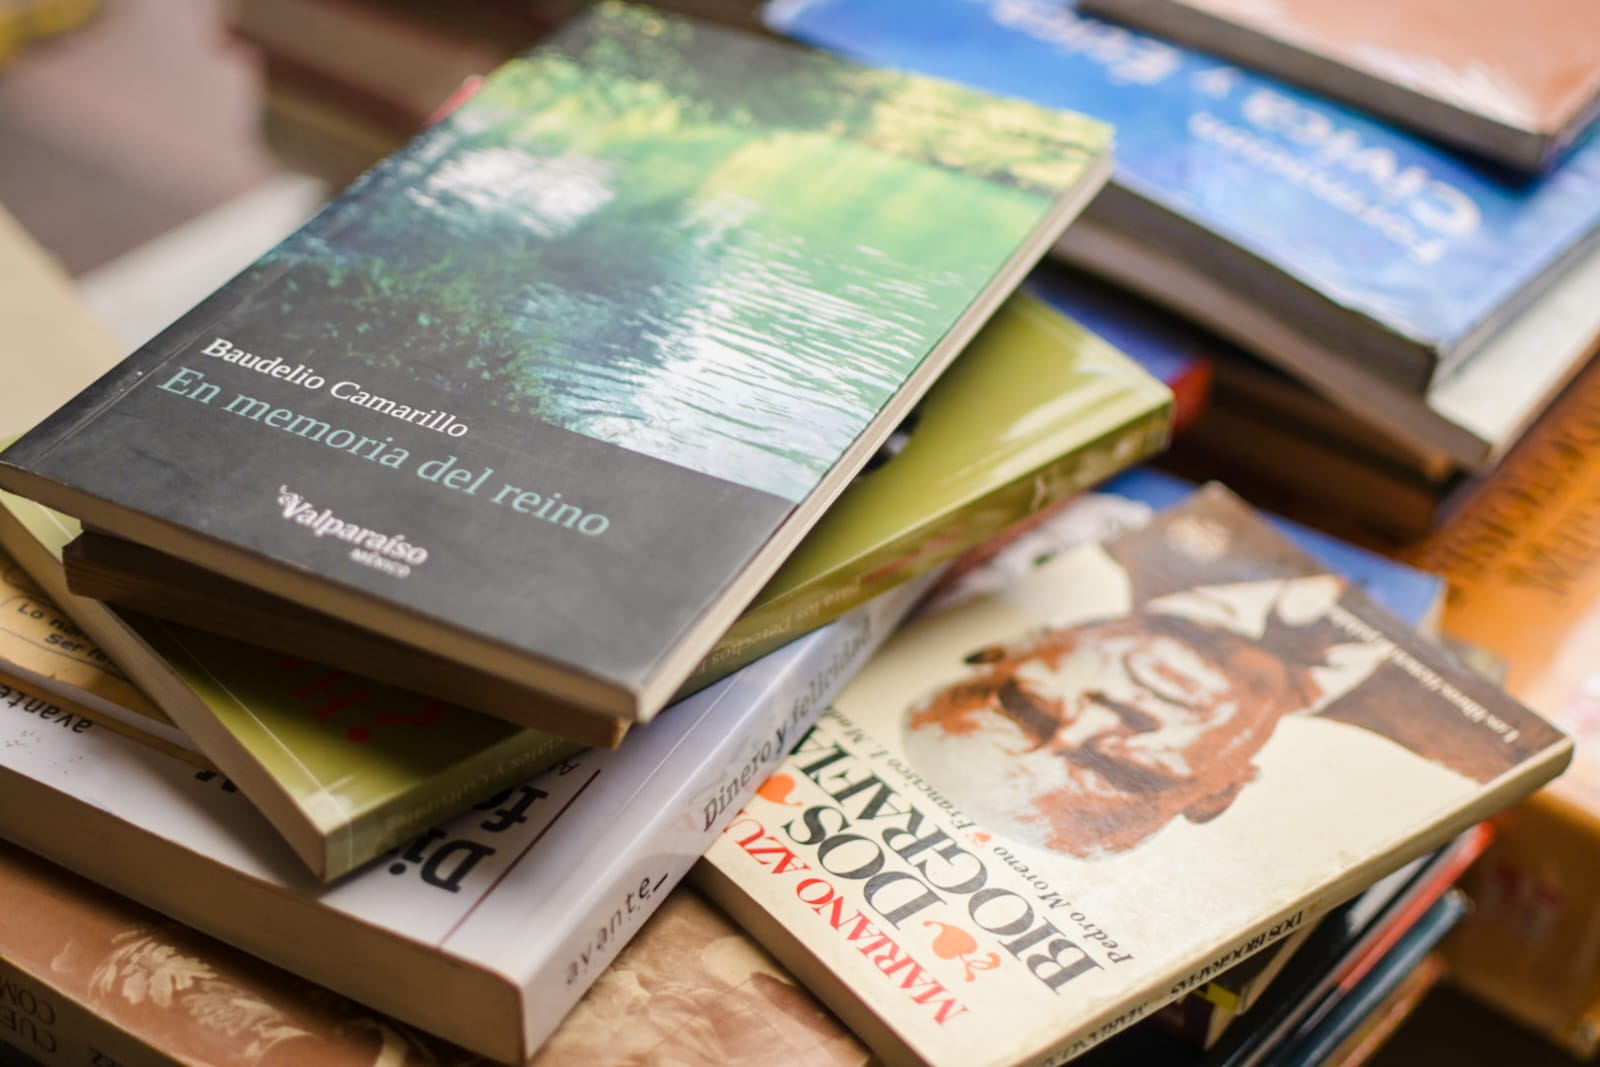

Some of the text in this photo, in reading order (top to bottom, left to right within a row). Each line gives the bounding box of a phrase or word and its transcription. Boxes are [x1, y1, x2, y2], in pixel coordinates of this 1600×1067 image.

[201, 337, 469, 438] Baudelio Camarillo
[157, 366, 611, 537] En memoria del reino
[277, 484, 429, 566] Valparaíso
[17, 603, 45, 620] Lo
[702, 740, 772, 833] Dinero
[775, 723, 788, 756] y
[887, 757, 977, 832] Francisco
[780, 805, 949, 931] DOS
[992, 845, 1073, 912] Moreno
[722, 809, 972, 1027] MARIANO AZU
[1069, 911, 1135, 965] Pedro
[1267, 911, 1305, 938] DOS
